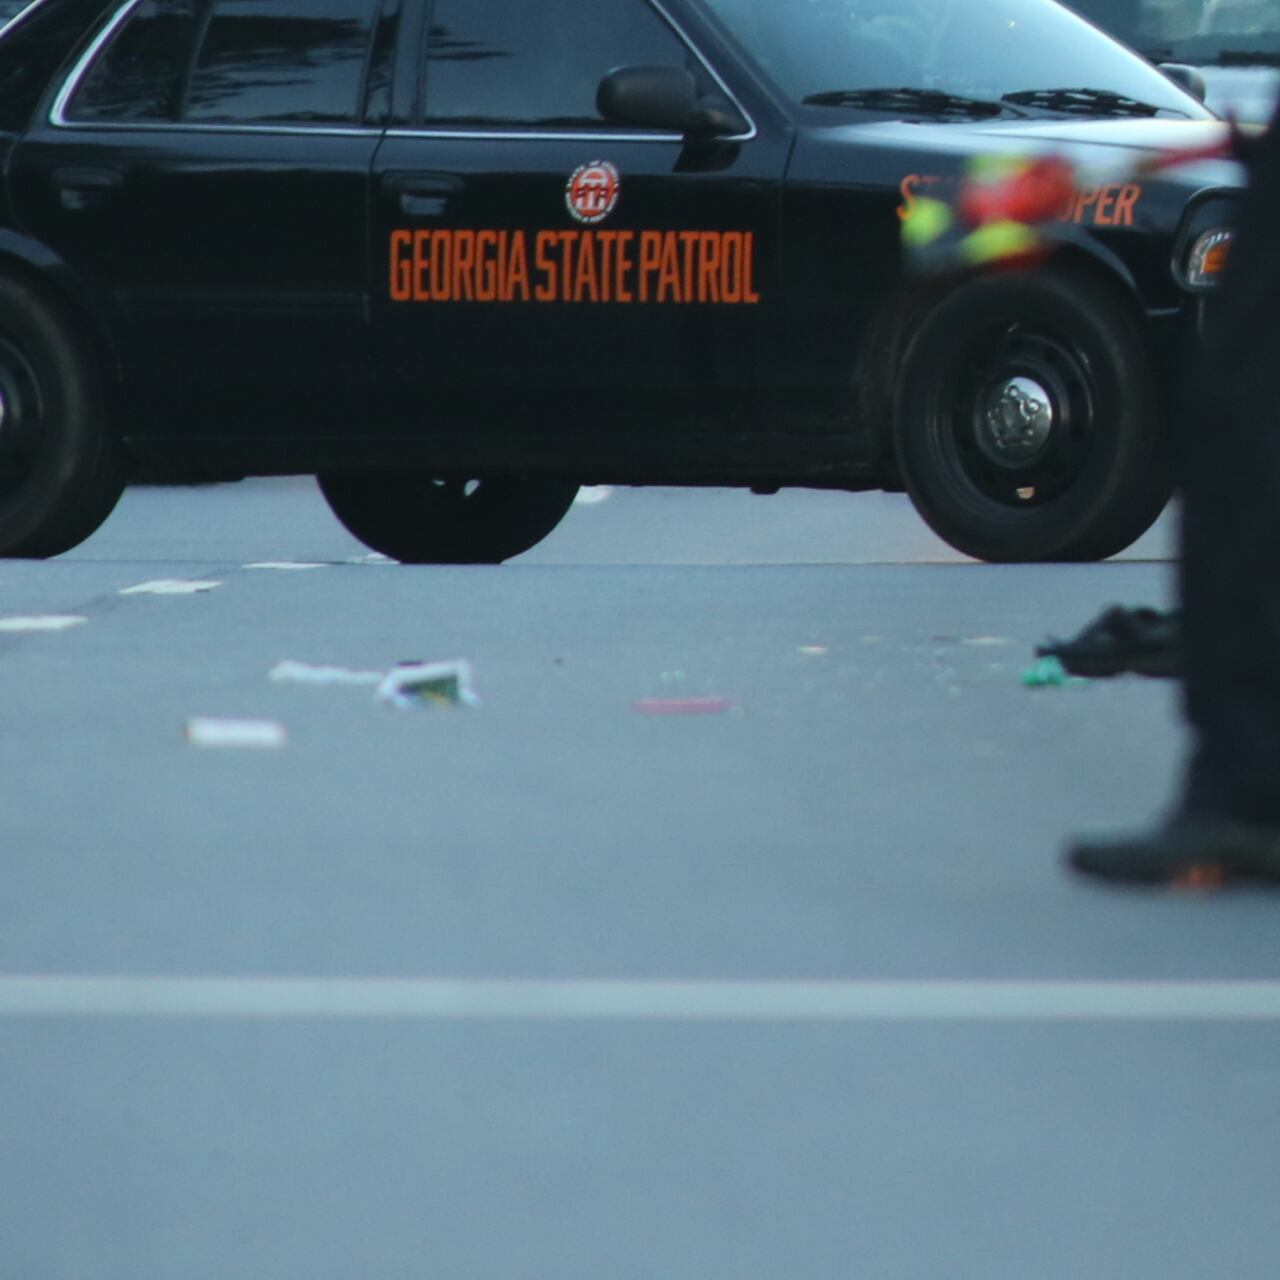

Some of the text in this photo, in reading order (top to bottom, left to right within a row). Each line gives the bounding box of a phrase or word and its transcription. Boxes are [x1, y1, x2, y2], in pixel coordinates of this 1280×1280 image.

[390, 230, 759, 303] GEORGIA STATE PATROL
